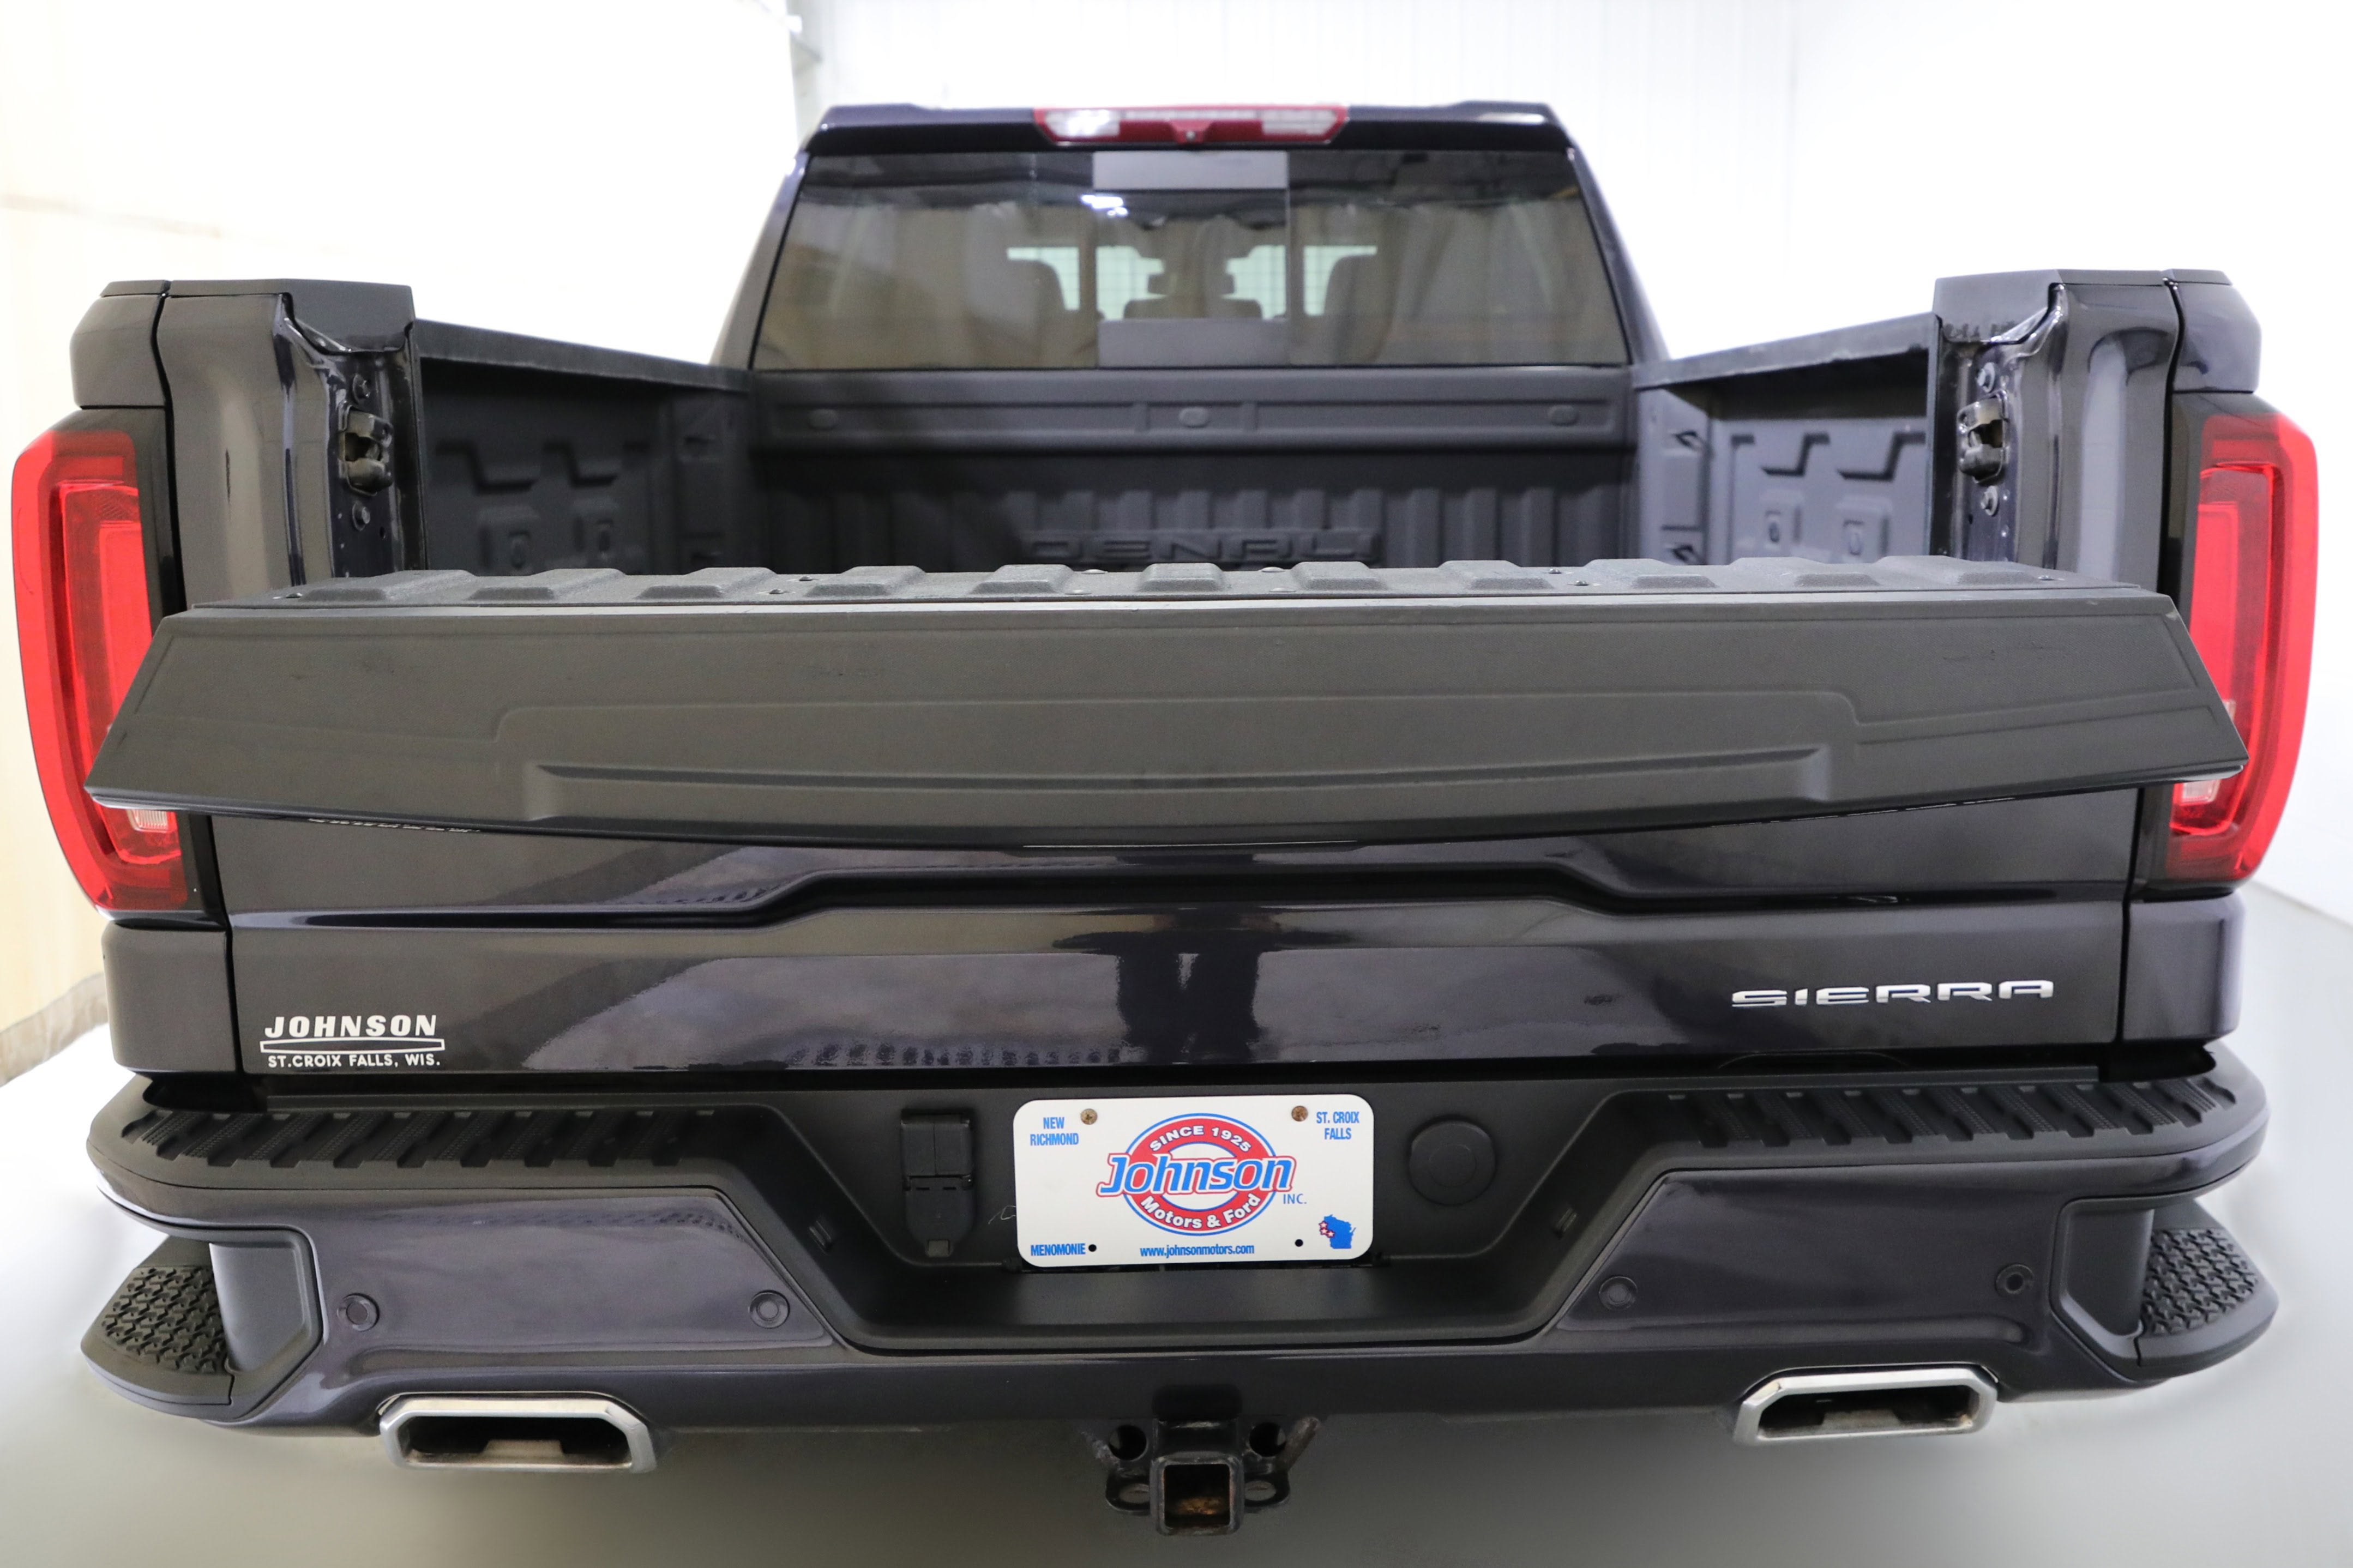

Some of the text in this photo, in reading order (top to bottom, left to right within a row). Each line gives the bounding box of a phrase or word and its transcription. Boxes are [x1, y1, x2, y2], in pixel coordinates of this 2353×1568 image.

[1732, 980, 2054, 1007] SIERRA
[264, 1015, 437, 1038] JOHNSON
[348, 1054, 399, 1068] FALLS,
[404, 1053, 441, 1066] WIS.
[1043, 1117, 1065, 1130] NEW
[1316, 1111, 1360, 1124] ST. CROIX
[1030, 1132, 1079, 1146] RICHMOND
[1149, 1125, 1252, 1153] SINCE 1925
[1324, 1127, 1352, 1141] FALLS
[1099, 1155, 1292, 1194] Johnson
[1283, 1193, 1308, 1205] INC.
[1140, 1192, 1261, 1229] Motors & Ford
[1030, 1242, 1086, 1257] MENOMONIE
[1139, 1244, 1255, 1259] www.johnsonmotors.com
